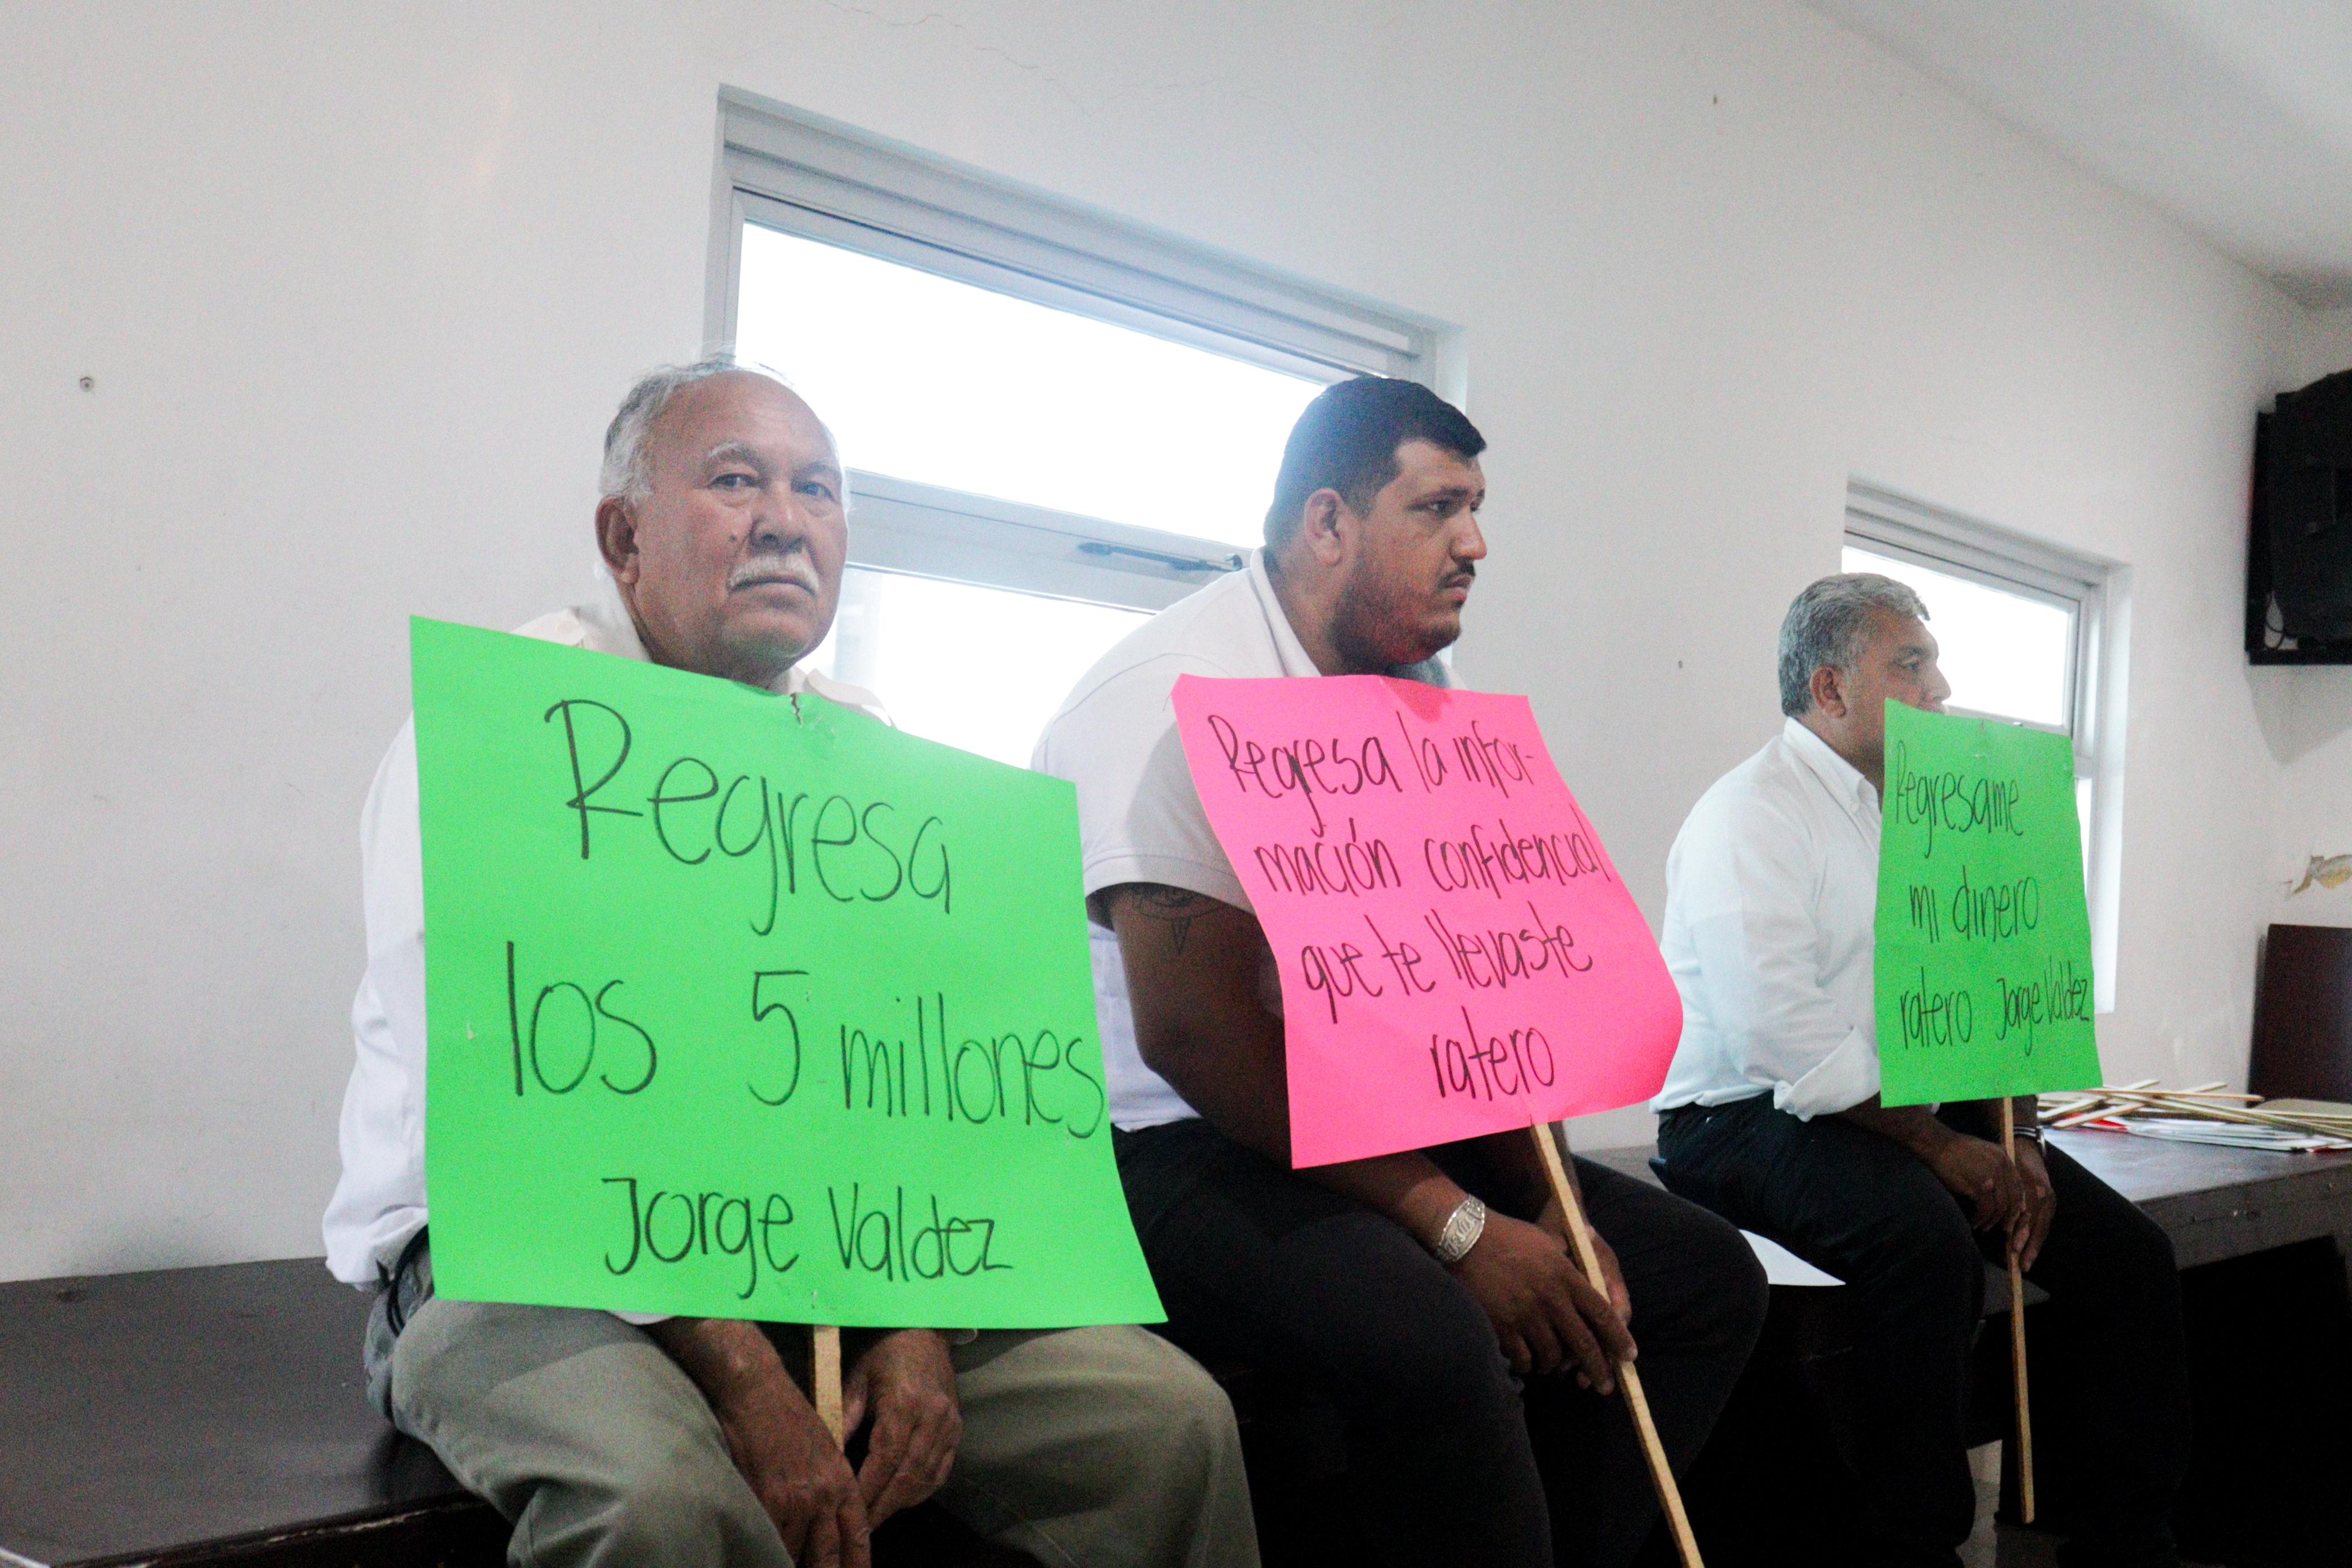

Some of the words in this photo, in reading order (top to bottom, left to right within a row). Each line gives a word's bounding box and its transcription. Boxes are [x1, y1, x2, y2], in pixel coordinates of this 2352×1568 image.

[544, 699, 951, 936] Regresa
[1207, 714, 1403, 838] Regresa
[1396, 711, 1448, 794] la
[1895, 740, 2024, 859] Regresame
[1253, 818, 1402, 897] mación
[1424, 803, 1611, 899] confidencial
[1909, 883, 1939, 943] mi
[1952, 865, 2039, 942] dinero
[1301, 941, 1383, 1024] que
[1364, 914, 1436, 997] te
[1424, 900, 1593, 989] llevaste
[1900, 967, 1973, 1050] ratero
[1996, 977, 2043, 1056] Jorge
[2044, 955, 2090, 1024] Valdez
[506, 941, 657, 1097] los
[748, 970, 808, 1105] 5
[841, 992, 1104, 1138] millones
[1430, 1006, 1555, 1102] ratero
[600, 1177, 799, 1299] Jorge
[828, 1183, 1013, 1281] Valdez
